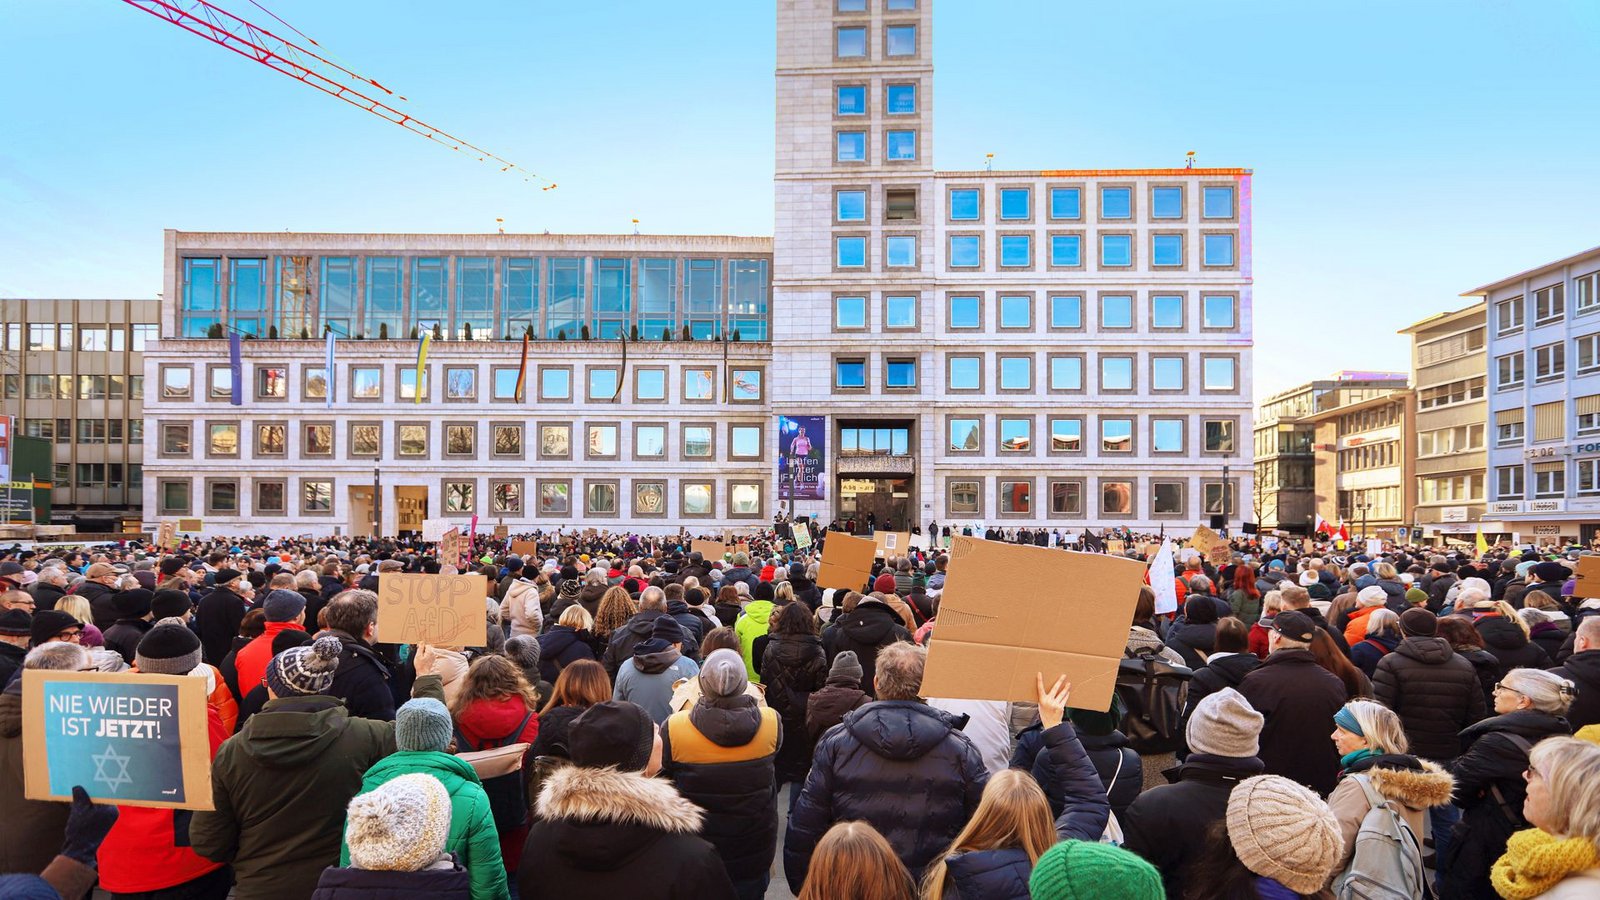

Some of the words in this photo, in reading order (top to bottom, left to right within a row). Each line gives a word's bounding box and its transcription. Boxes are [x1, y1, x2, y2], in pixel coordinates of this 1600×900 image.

[386, 575, 471, 606] STOPP
[401, 606, 459, 643] AfD
[50, 695, 83, 714] NIE
[88, 696, 172, 717] WIEDER
[62, 717, 91, 737] IST
[95, 718, 161, 739] JETZT!
